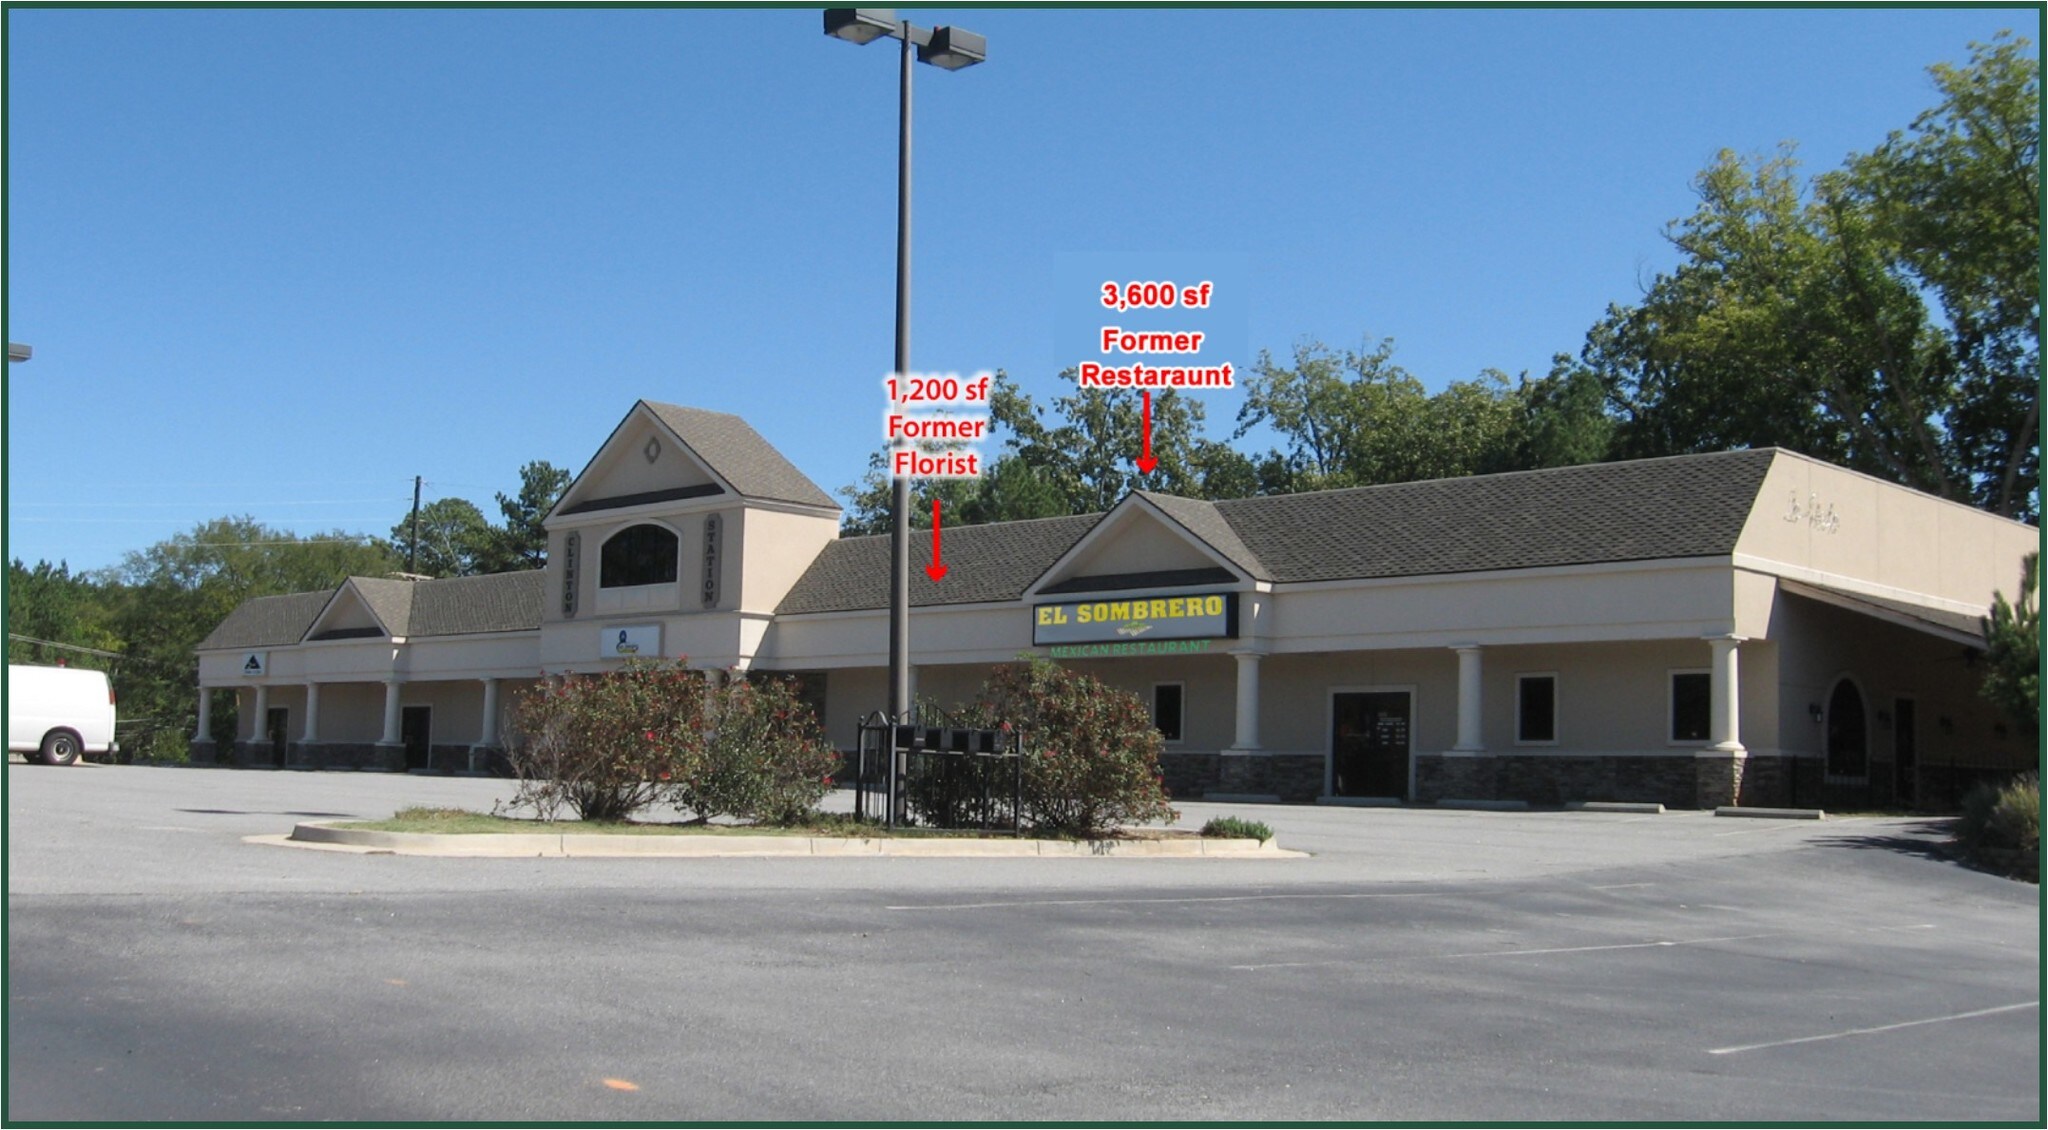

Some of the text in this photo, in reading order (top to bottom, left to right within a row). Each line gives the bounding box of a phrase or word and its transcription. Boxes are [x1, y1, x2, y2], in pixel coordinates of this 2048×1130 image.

[564, 537, 576, 612] CLINTON
[704, 520, 716, 602] STATION
[1038, 595, 1223, 625] EL SOMBRERO
[1051, 640, 1212, 658] MEXICAN RESTAURANT
